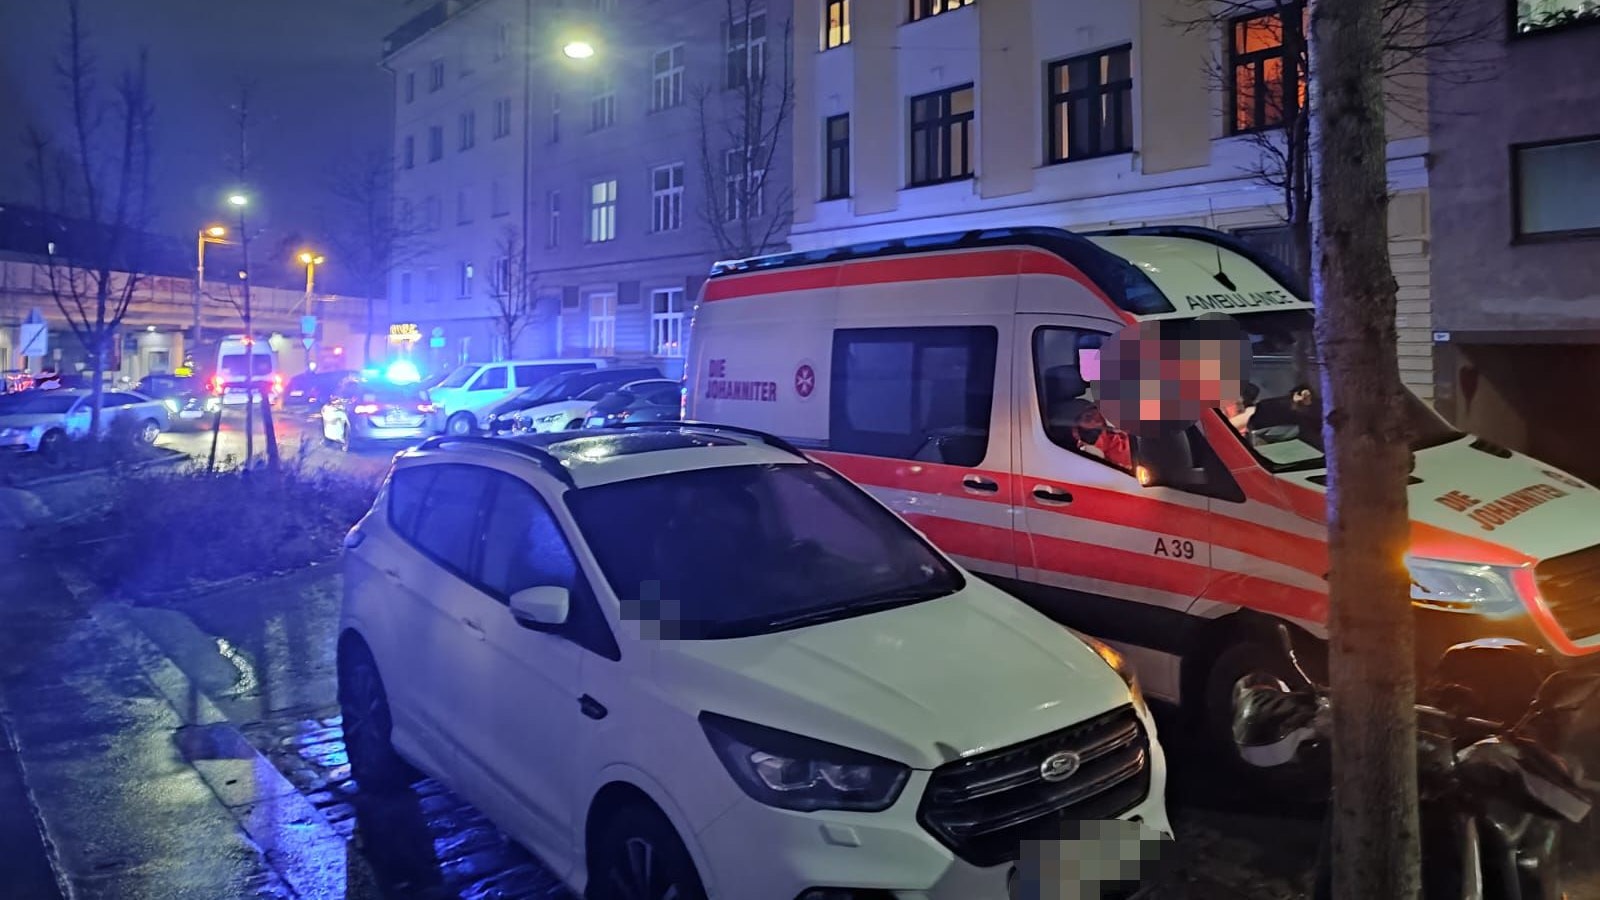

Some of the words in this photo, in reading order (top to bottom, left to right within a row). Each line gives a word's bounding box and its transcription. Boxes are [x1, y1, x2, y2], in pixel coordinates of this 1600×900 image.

[1185, 290, 1294, 311] AMBULANCE
[708, 359, 726, 378] DIE
[705, 380, 777, 402] JOHANNITER
[1434, 489, 1482, 512] DIE
[1154, 537, 1169, 557] A
[1171, 539, 1195, 560] 39
